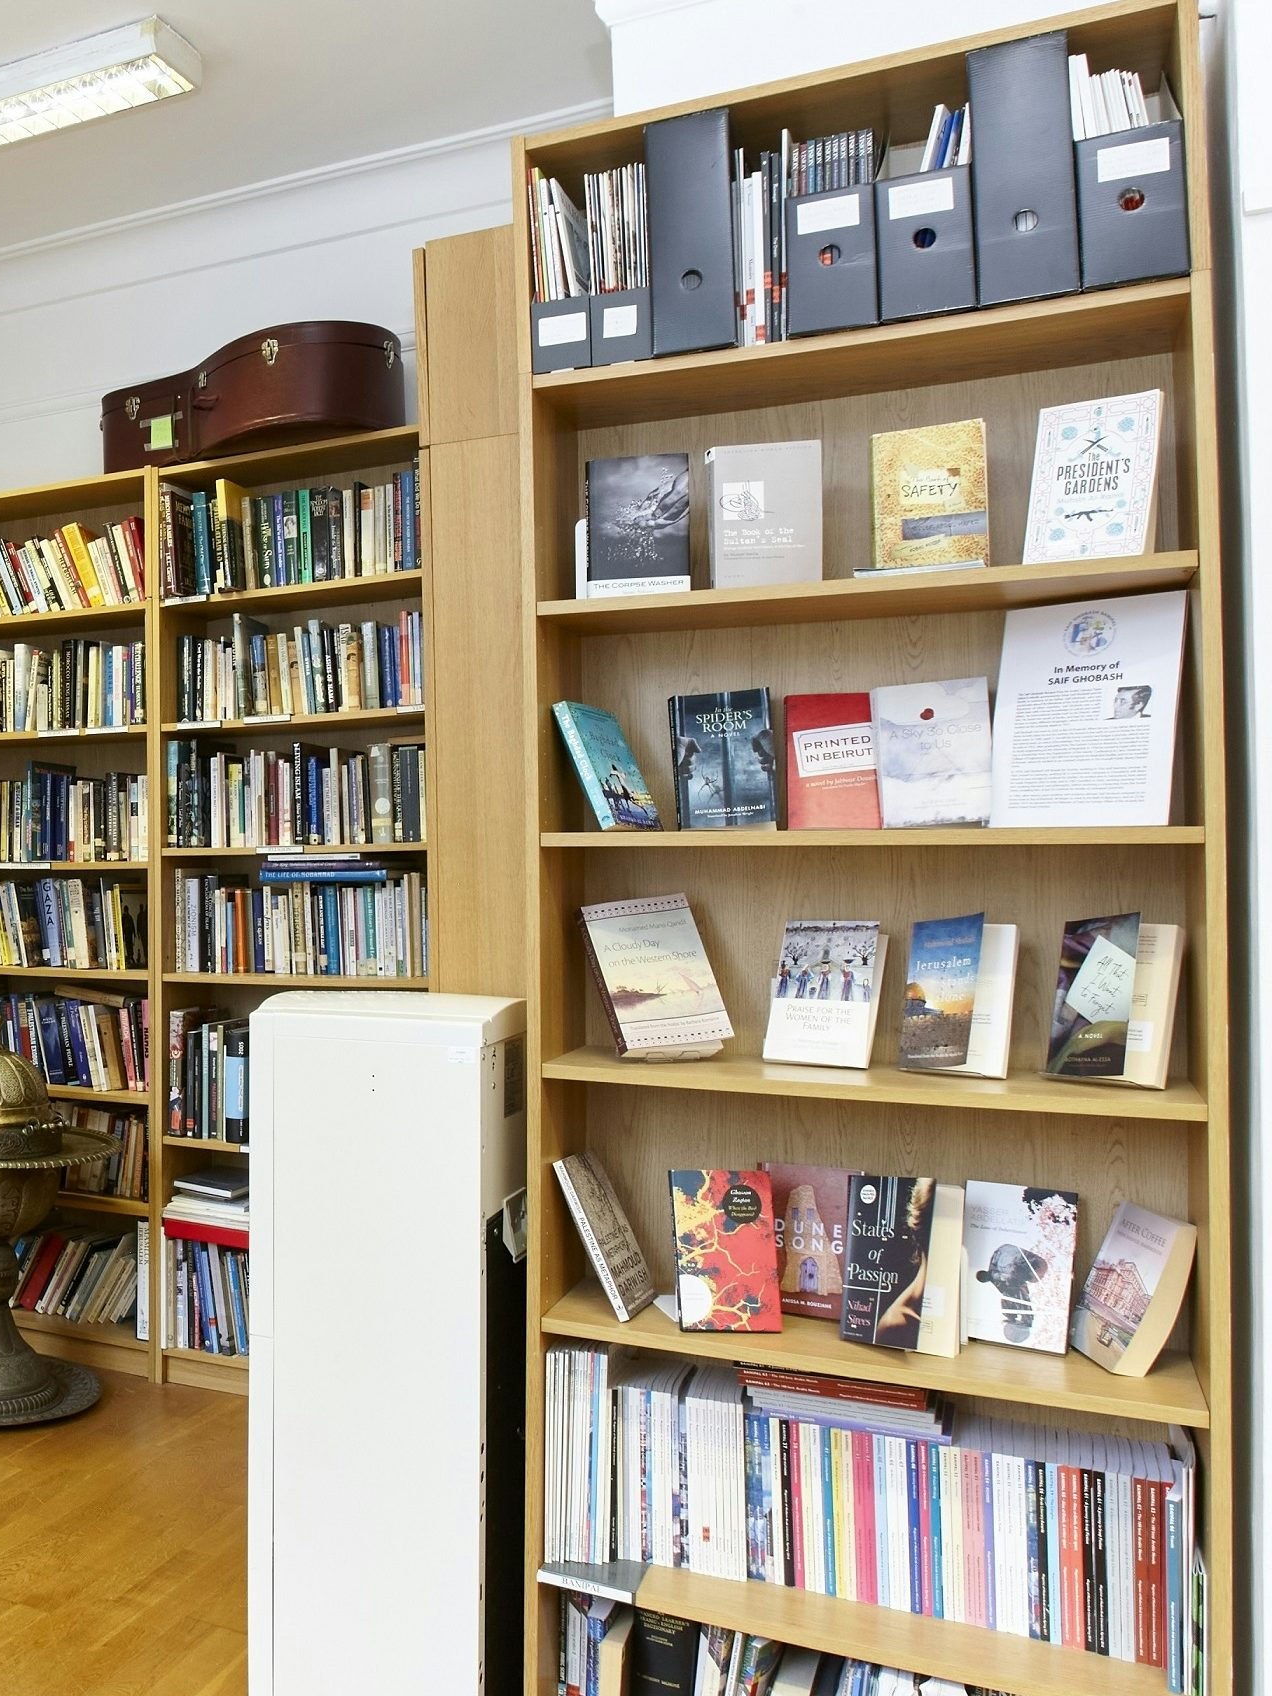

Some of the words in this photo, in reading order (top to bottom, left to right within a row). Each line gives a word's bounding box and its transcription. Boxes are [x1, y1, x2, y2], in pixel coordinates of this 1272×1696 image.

[1088, 453, 1100, 461] The
[1057, 458, 1131, 481] PRESIDENT'S
[901, 482, 958, 498] SAFETY
[1064, 475, 1119, 495] GARDENS
[723, 536, 766, 545] Sultan's
[741, 529, 761, 537] Book
[59, 557, 77, 595] HEZBOLLAH
[1054, 665, 1063, 674] In
[1065, 663, 1107, 673] Memory
[1108, 660, 1120, 670] of
[1047, 676, 1070, 686] SAIF
[1072, 673, 1123, 684] GHOBASH
[695, 709, 753, 724] SPIDER'S
[702, 720, 747, 733] ROOM
[889, 731, 900, 740] A
[902, 728, 923, 740] Sky
[927, 726, 943, 737] So
[946, 723, 981, 735] Close
[561, 714, 570, 728] The
[579, 756, 591, 781] Clock
[803, 735, 871, 751] PRINTED
[920, 741, 931, 750] to
[936, 739, 952, 749] Us
[805, 754, 820, 763] IN
[822, 747, 873, 761] BEIRUT
[694, 807, 731, 815] MUHAMMAD
[42, 882, 54, 926] GAZA
[603, 945, 611, 953] A
[613, 940, 642, 952] Cloudy
[643, 939, 660, 949] Day
[608, 960, 620, 968] on
[621, 957, 636, 966] the
[637, 954, 671, 964] Western
[673, 950, 697, 959] Shore
[915, 956, 971, 972] Jerusalem
[787, 1004, 814, 1014] PRAISE
[817, 1006, 833, 1014] FOR
[836, 1007, 853, 1015] THE
[785, 1013, 818, 1023] WOMEN
[836, 1017, 853, 1025] THE
[802, 1022, 830, 1031] FAMILY
[61, 1016, 71, 1049] PALESTINIAN
[66, 1047, 74, 1068] PEOPLE
[971, 1205, 1008, 1215] YASSER
[775, 1218, 842, 1239] DUNE
[851, 1218, 895, 1239] States
[775, 1234, 844, 1255] SONG
[1140, 1227, 1168, 1248] COFFEE
[579, 1217, 598, 1255] PALESTINE
[593, 1253, 601, 1263] AS
[598, 1263, 618, 1300] METAPHOR
[868, 1248, 884, 1264] of
[610, 1251, 642, 1280] MAHMOUD
[849, 1262, 899, 1285] Passion
[618, 1271, 648, 1297] DARWISH
[847, 1299, 872, 1313] Nihad
[847, 1313, 871, 1327] Sirees
[562, 1577, 601, 1594] BANIPAL
